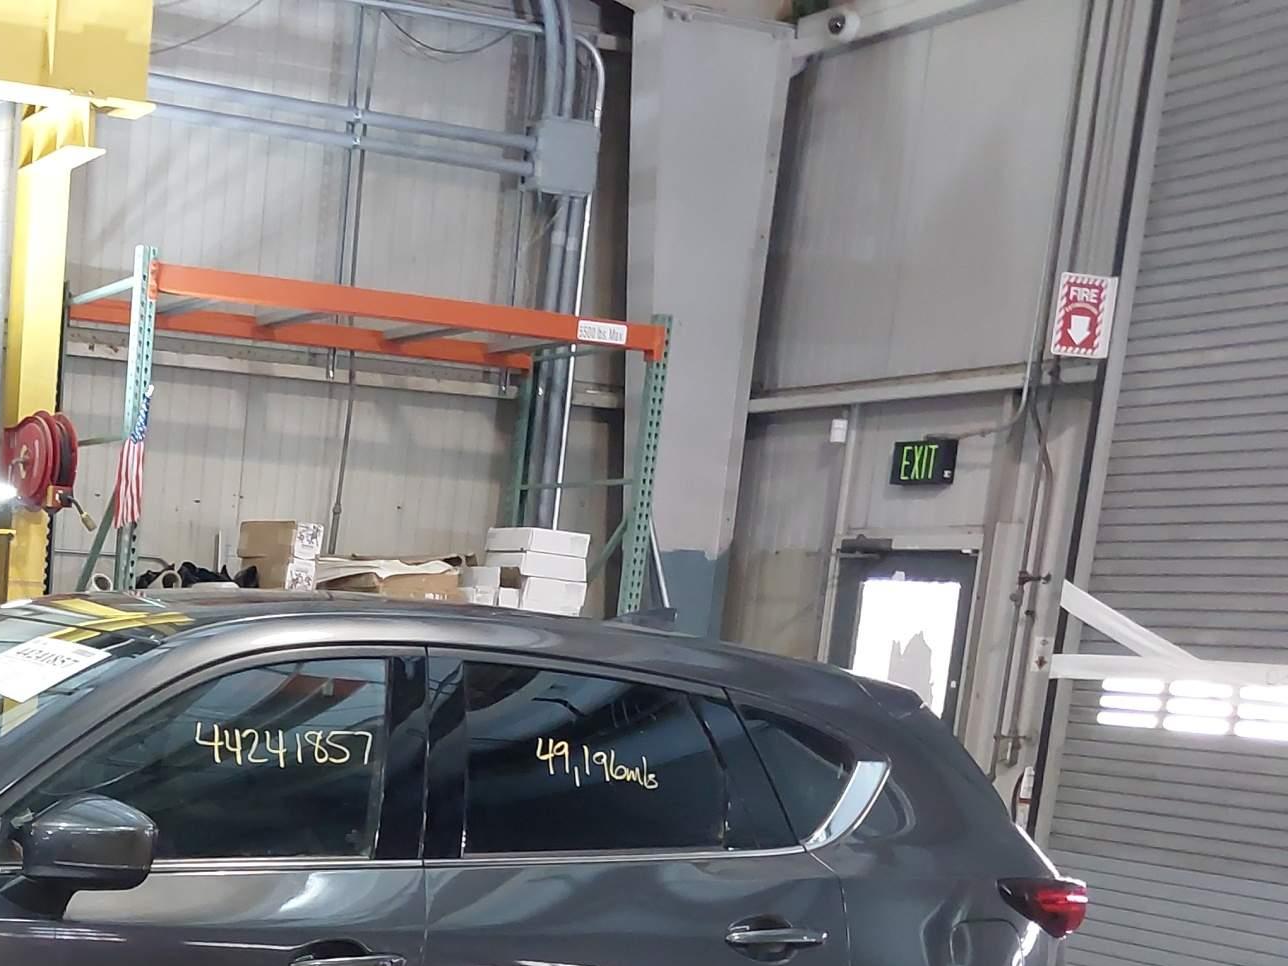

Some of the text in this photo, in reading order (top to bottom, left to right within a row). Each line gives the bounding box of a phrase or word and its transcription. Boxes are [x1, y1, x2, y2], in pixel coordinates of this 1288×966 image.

[1069, 286, 1100, 304] FIRE
[900, 444, 938, 480] EXIT
[195, 721, 373, 769] 44241857
